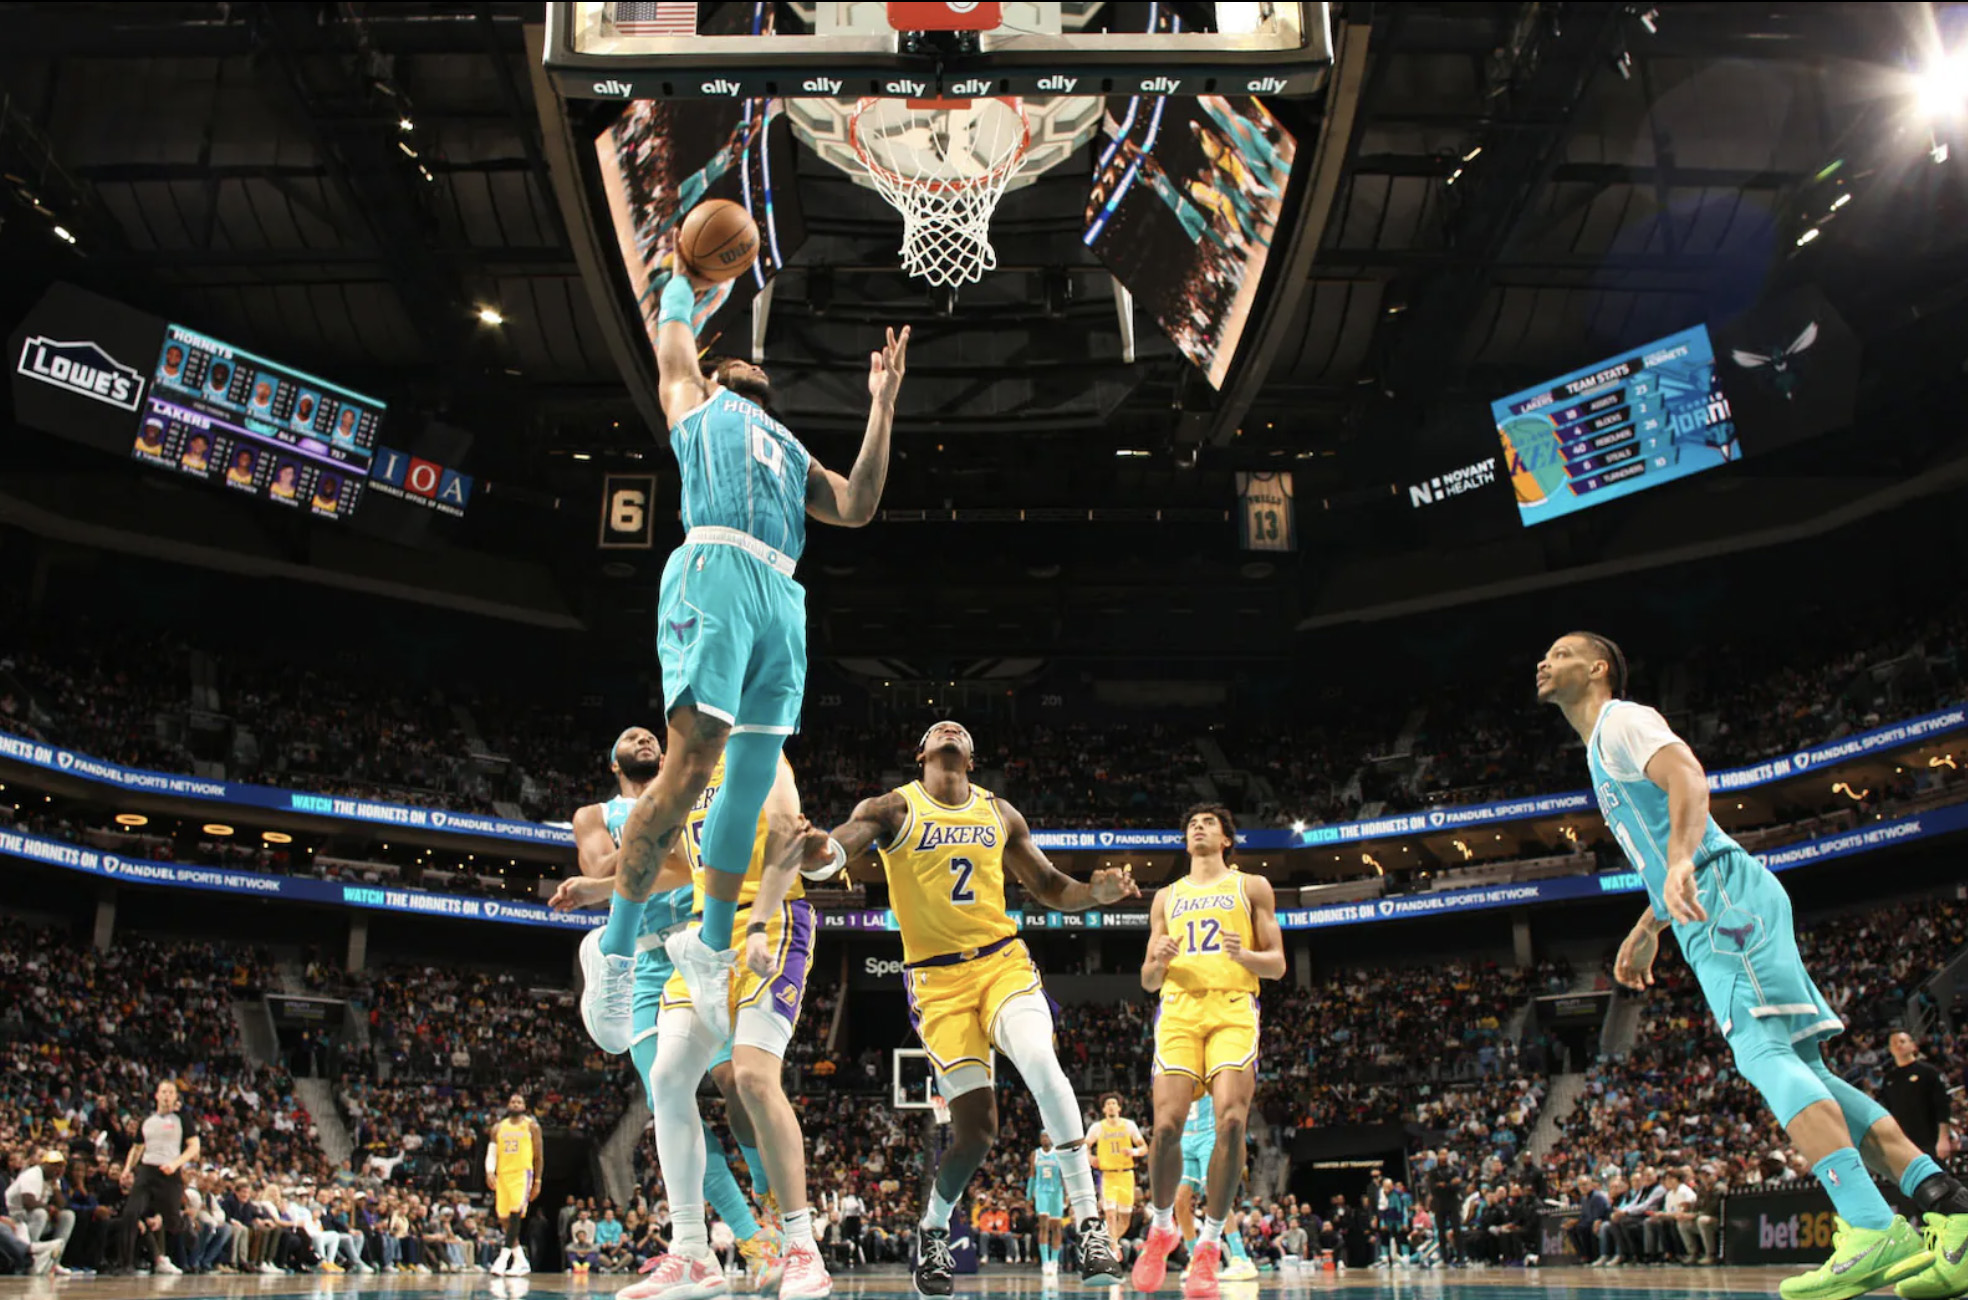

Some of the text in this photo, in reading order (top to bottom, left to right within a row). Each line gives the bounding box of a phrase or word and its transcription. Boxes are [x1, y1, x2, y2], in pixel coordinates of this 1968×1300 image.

[593, 80, 632, 98] ally
[701, 79, 741, 97] ally
[802, 77, 843, 95] ally
[886, 79, 925, 97] ally
[952, 79, 992, 95] ally
[1037, 75, 1077, 92] ally
[1140, 77, 1181, 94] ally
[1247, 77, 1288, 94] ally
[172, 328, 234, 360] HORNETS
[33, 346, 132, 401] LOWE'S
[1566, 376, 1597, 395] TEAM
[1596, 363, 1630, 384] STATS
[152, 401, 212, 430] LAKERS
[1443, 457, 1496, 485] NOVANT
[1445, 471, 1495, 497] HEALTH
[610, 489, 645, 532] 6
[1255, 510, 1278, 540] 13
[1721, 764, 1774, 788] HORNETS
[1774, 759, 1791, 775] ON
[1811, 742, 1862, 763] FANDUEL
[1862, 728, 1905, 749] SPORTS
[1906, 710, 1965, 736] NETWORK
[34, 746, 52, 764] ON
[74, 759, 123, 783] FANDUEL
[123, 773, 168, 789] SPORTS
[169, 779, 225, 796] NETWORK
[292, 794, 333, 813] WATCH
[333, 800, 355, 816] THE
[357, 804, 408, 822] HORNETS
[410, 809, 426, 824] ON
[447, 817, 495, 833] FANDUEL
[496, 823, 533, 837] SPORTS
[1302, 828, 1339, 844] WATCH
[1339, 825, 1360, 839] THE
[1361, 819, 1408, 837] HORNETS
[1409, 816, 1426, 830] ON
[1446, 808, 1495, 823] FANDUEL
[1496, 803, 1535, 817] SPORTS
[1536, 795, 1588, 812] NETWORK
[913, 821, 998, 852] LAKERS
[1031, 833, 1078, 846] HORNETS
[1080, 833, 1095, 846] ON
[1116, 835, 1160, 845] FANDUEL
[1769, 820, 1921, 866] FANDUEL SPORTS NETWORK
[24, 838, 80, 865] HORNETS
[80, 854, 98, 869] ON
[119, 863, 175, 880] FANDUEL
[177, 870, 222, 885] SPORTS
[223, 876, 281, 892] NETWORK
[948, 857, 976, 905] 2
[1600, 872, 1643, 890] WATCH
[343, 886, 384, 905] WATCH
[386, 892, 409, 907] THE
[410, 894, 461, 914] HORNETS
[462, 901, 479, 914] ON
[500, 906, 548, 922] FANDUEL
[549, 911, 588, 926] SPORTS
[1169, 894, 1236, 920] LAKERS
[1288, 912, 1307, 926] THE
[1309, 907, 1358, 924] HORNETS
[1359, 904, 1375, 918] ON
[1396, 898, 1444, 912] FANDUEL
[1445, 893, 1485, 907] SPORTS
[1486, 887, 1539, 902] NETWORK
[825, 915, 856, 926] FLS 1
[863, 914, 885, 927] LAL
[1026, 915, 1045, 926] FLS
[1051, 915, 1058, 925] 1
[1063, 915, 1083, 926] TOL
[1089, 915, 1098, 925] 3
[1186, 918, 1222, 955] 12
[504, 1140, 518, 1153] 23
[1110, 1141, 1120, 1154] 11
